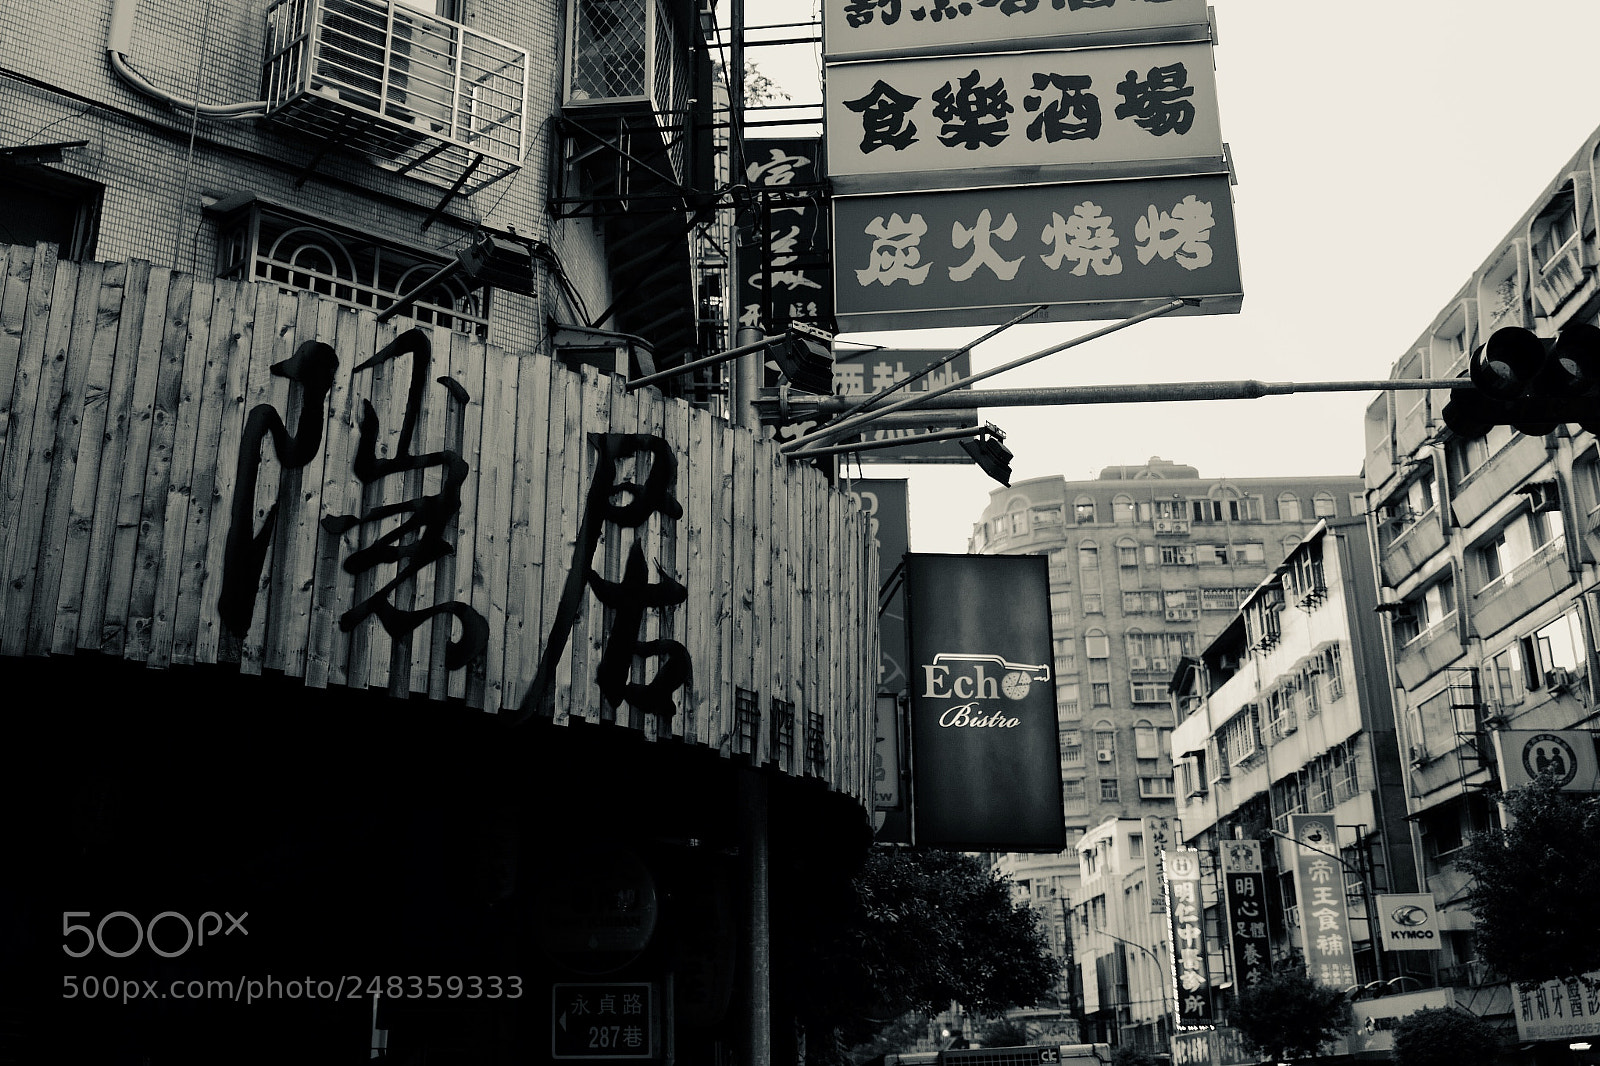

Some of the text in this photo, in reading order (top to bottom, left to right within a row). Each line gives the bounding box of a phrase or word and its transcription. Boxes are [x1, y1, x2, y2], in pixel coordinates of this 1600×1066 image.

[842, 62, 1196, 154] 食樂酒場
[854, 194, 1216, 287] 炭火燒烤
[938, 701, 1021, 730] Bistro
[1308, 858, 1344, 957] 帝王食補
[1391, 929, 1434, 940] KYMCO
[570, 993, 643, 1016] 永貞路
[588, 1024, 643, 1049] 287巷
